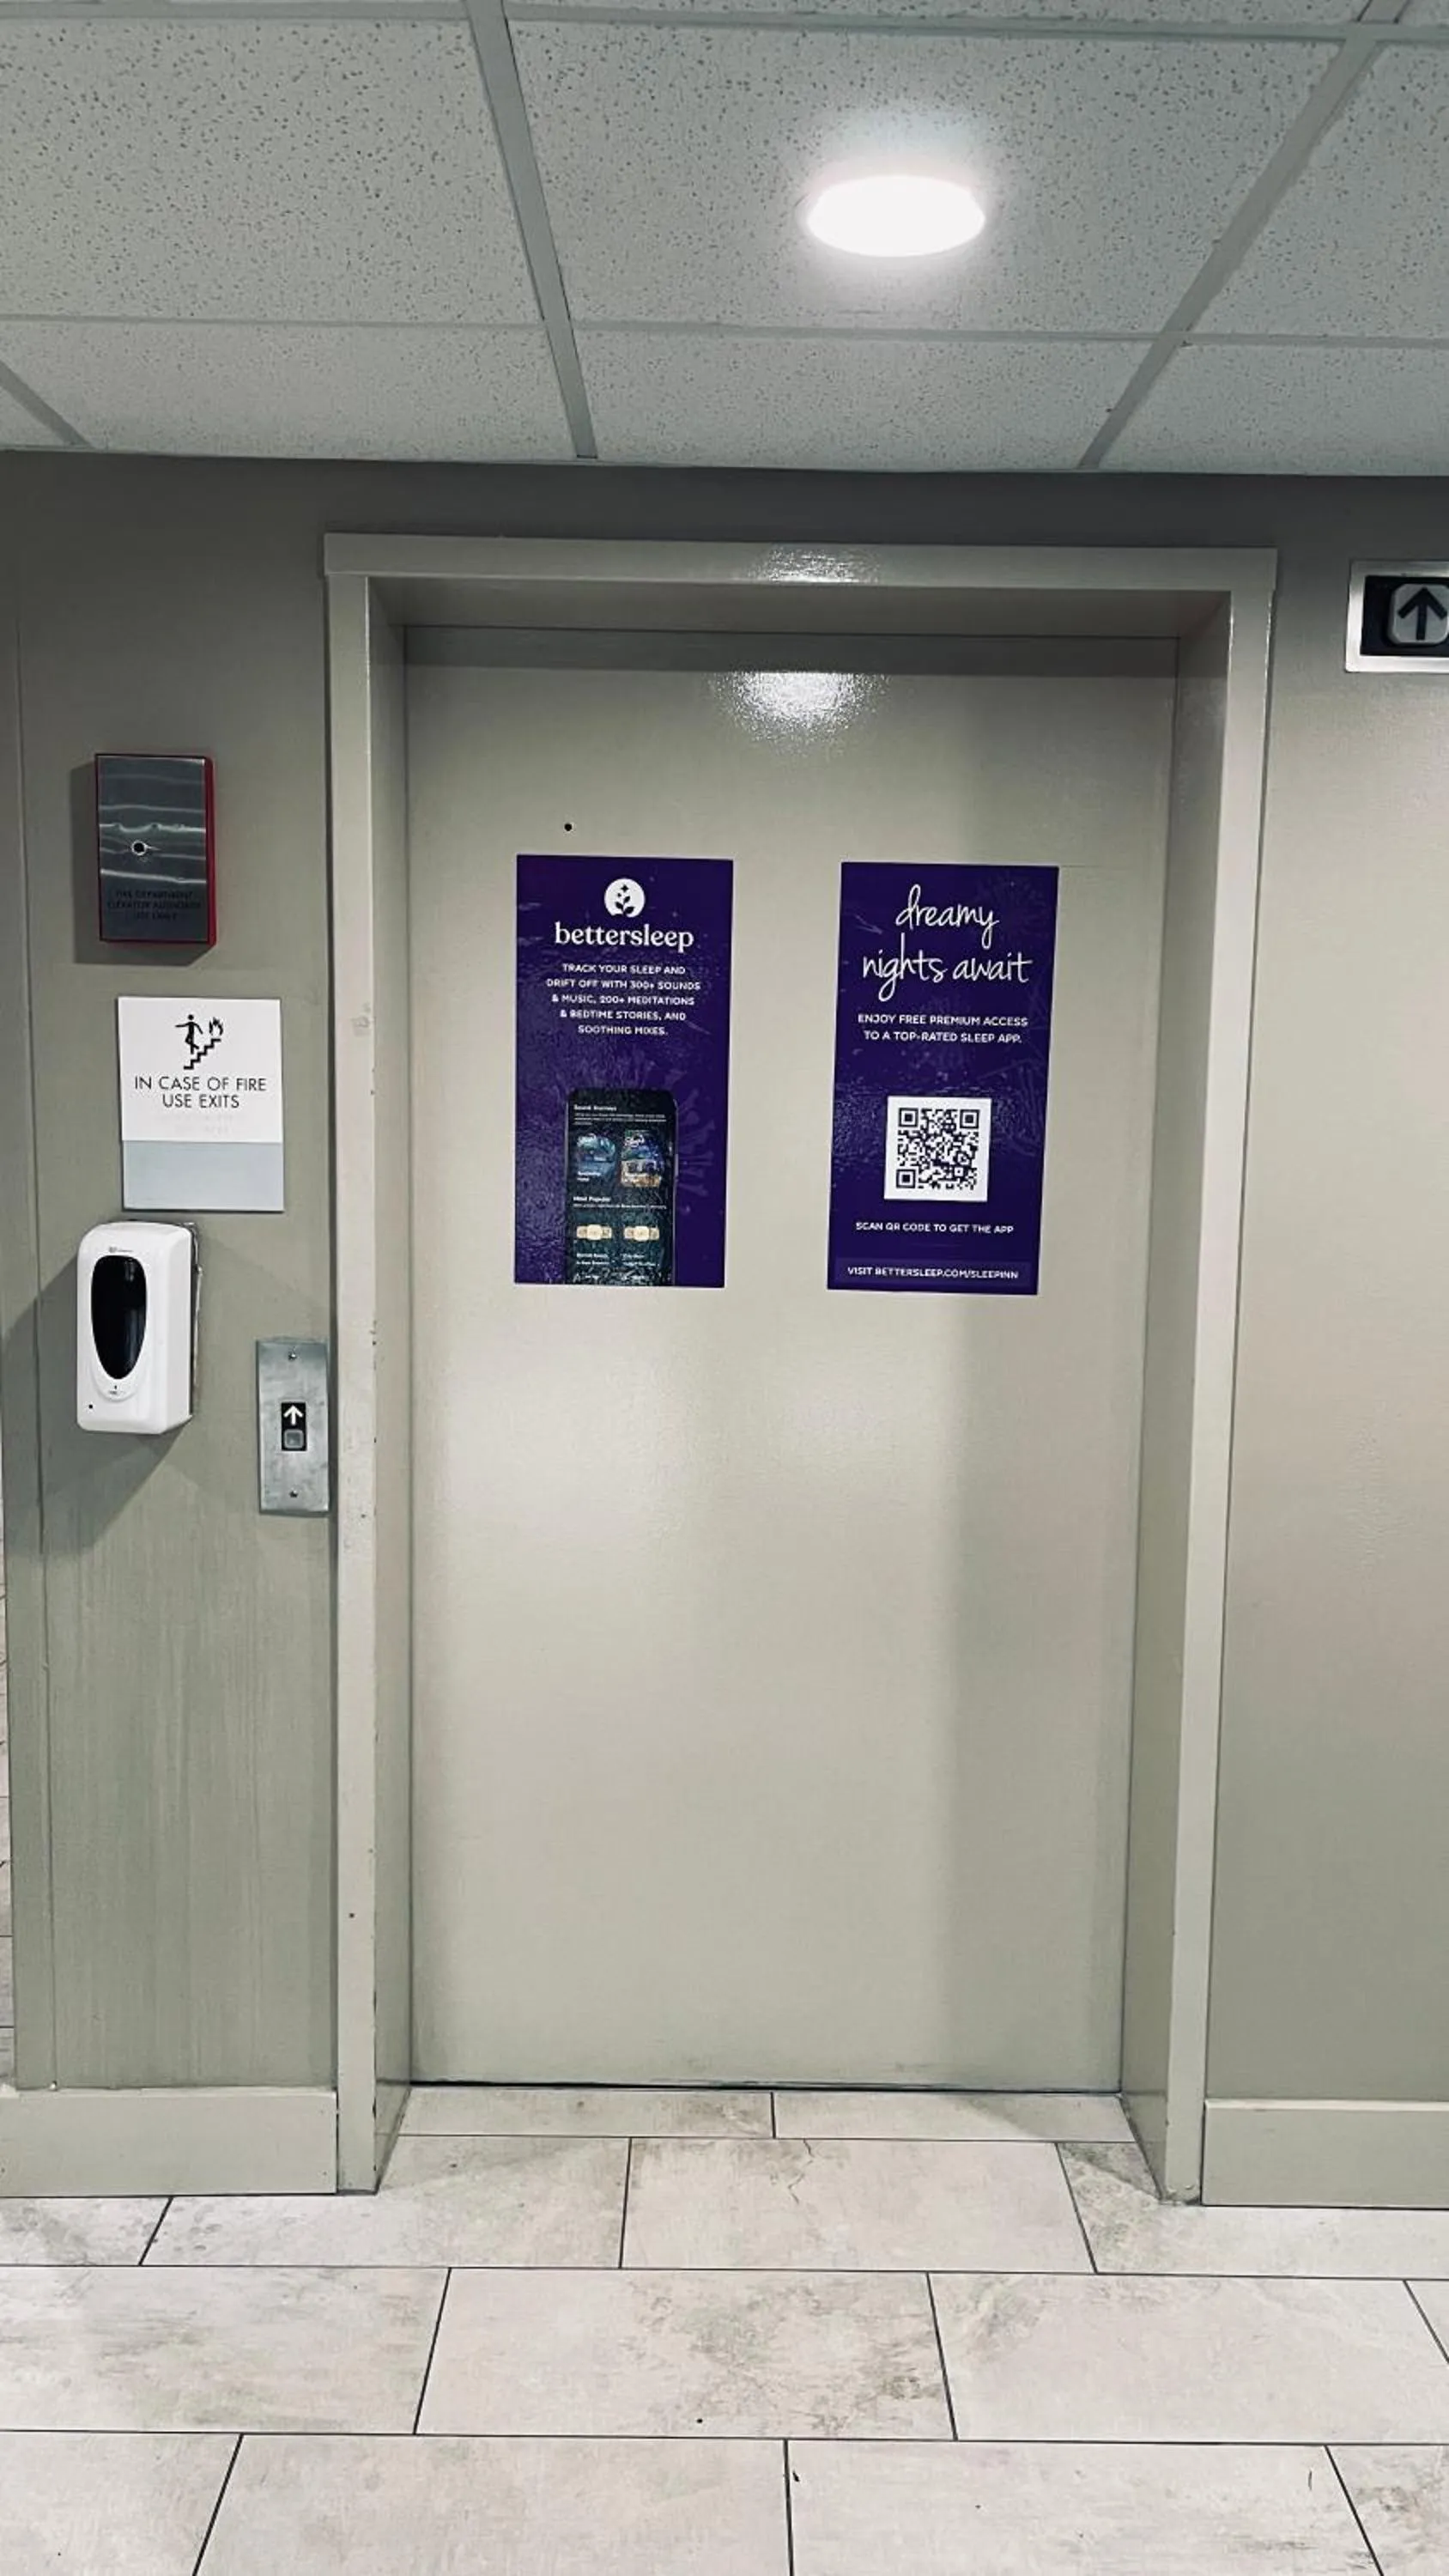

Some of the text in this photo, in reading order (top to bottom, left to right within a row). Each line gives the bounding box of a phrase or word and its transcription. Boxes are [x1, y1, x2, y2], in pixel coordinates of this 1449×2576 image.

[895, 884, 1000, 950] dreamy
[555, 920, 694, 953] bettersleep
[562, 963, 686, 975] TRACK YOUR SLEEP AND
[863, 932, 1034, 1002] nights await
[546, 978, 701, 991] DRIFT OFF WITH 300+ SOUNDS
[552, 994, 559, 1003] &
[599, 995, 626, 1004] 200+
[627, 996, 695, 1006] MEDITATIONS
[560, 1009, 687, 1022] & BEDTIME STORIES, AND
[858, 1013, 1028, 1027] ENJOY FREE PREMIUM ACCESS
[578, 1024, 669, 1036] SOOTHING MIXES.
[864, 1030, 1023, 1044] TO A TOP-RATED SLEEP APP.
[135, 1076, 267, 1091] IN CASE OF FIRE
[162, 1094, 239, 1109] USE EXITS
[856, 1222, 1014, 1234] SCAN QR CODE TO GET THE APP
[847, 1267, 873, 1275] VISIT
